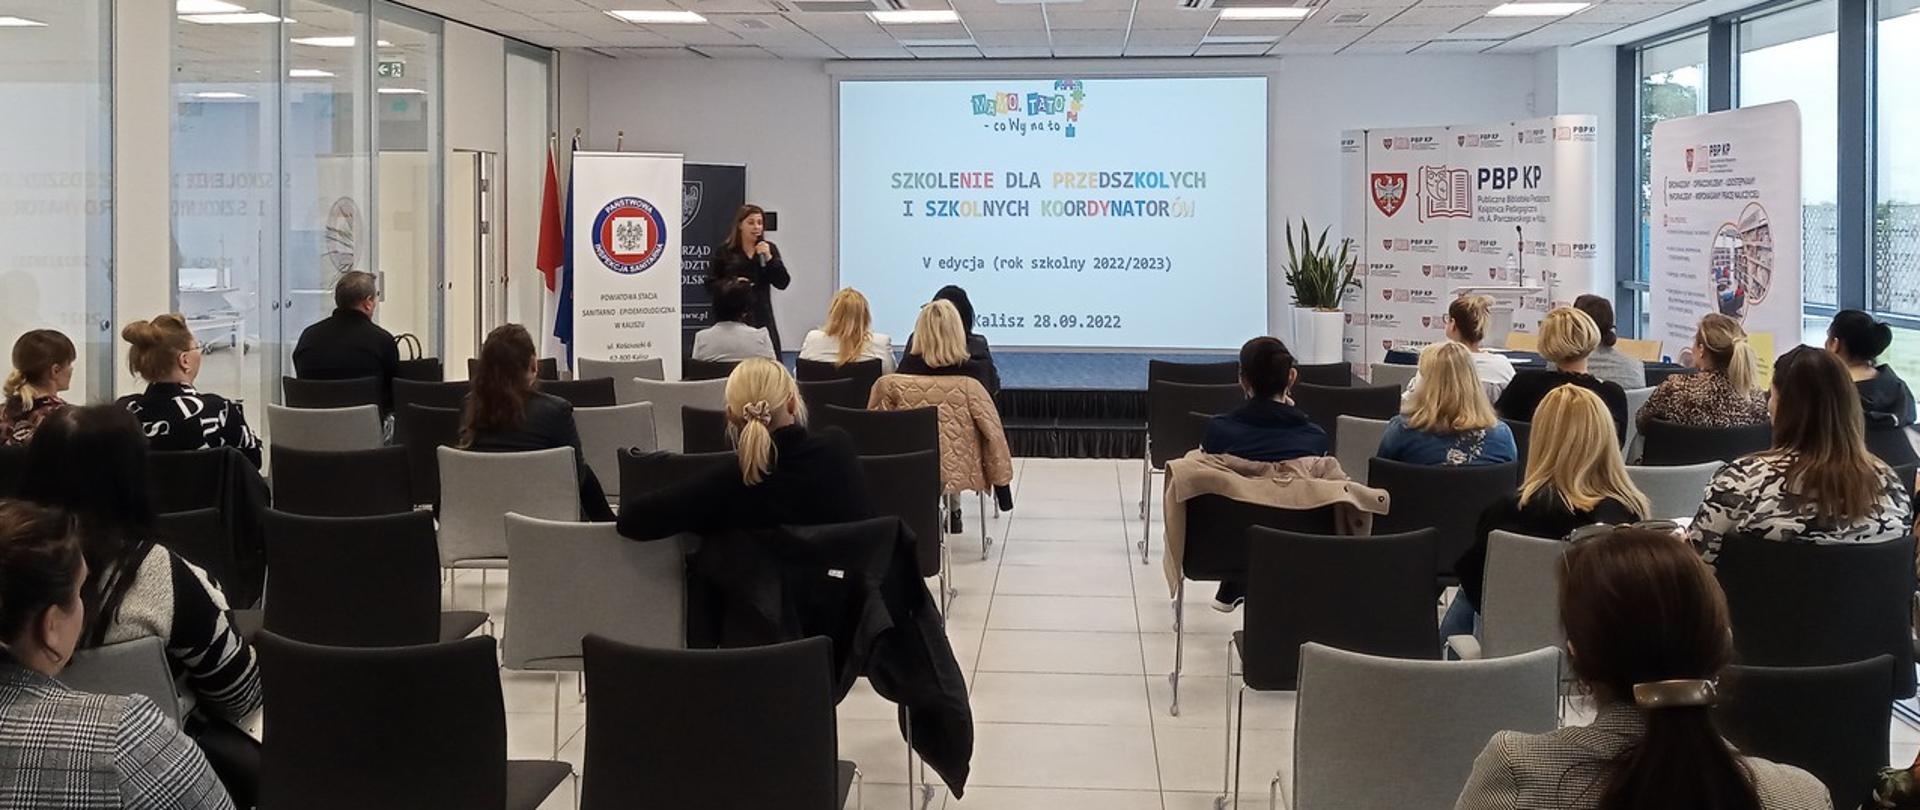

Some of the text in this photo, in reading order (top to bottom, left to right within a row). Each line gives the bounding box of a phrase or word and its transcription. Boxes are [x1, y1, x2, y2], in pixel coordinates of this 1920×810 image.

[994, 121, 1006, 132] co
[1008, 118, 1027, 136] Wy
[1031, 121, 1044, 131] na
[1049, 120, 1061, 132] to
[891, 172, 1206, 189] SZKOLENIE DLA PRZEDSZKOLYCH
[1477, 165, 1541, 190] PBP KP
[605, 199, 653, 214] PAŃSTWOWA
[903, 197, 1196, 218] I SZKOLNYCH KOORDYNATORÓW
[594, 243, 664, 273] INSPEKCJA SANITARNA
[682, 245, 711, 258] RZĄD
[923, 257, 1173, 271] V edycja (rok szkolny 2022/2023)
[600, 293, 637, 301] POWIATOWA
[582, 306, 676, 317] SANITARNO EPIDEMIOLOGICZNA
[614, 320, 645, 329] W KALISZU
[973, 314, 1122, 329] Kalisz 28.09.2022
